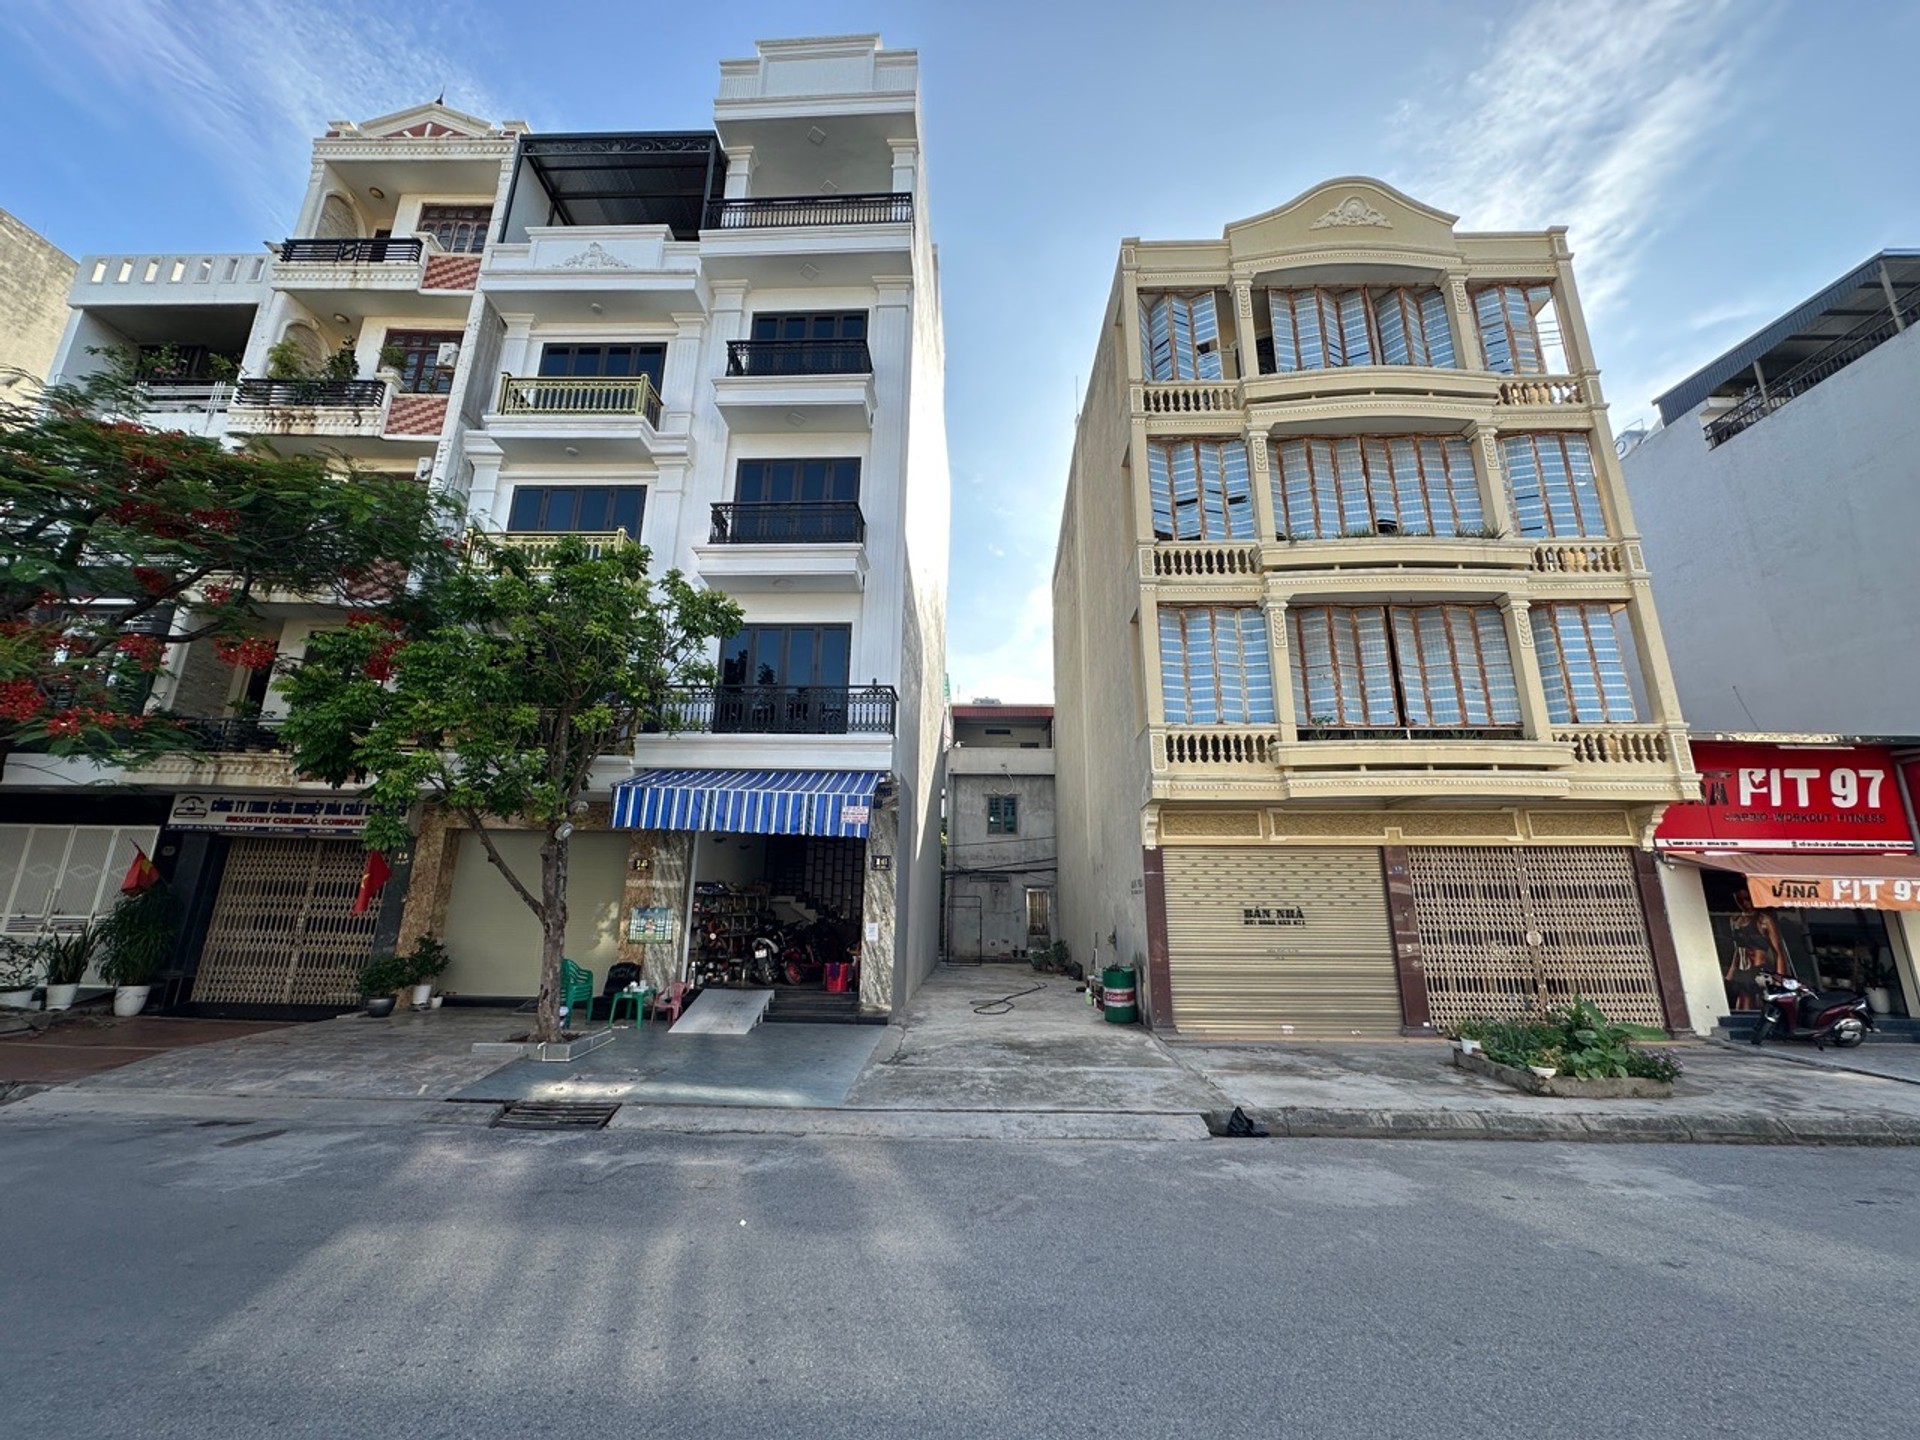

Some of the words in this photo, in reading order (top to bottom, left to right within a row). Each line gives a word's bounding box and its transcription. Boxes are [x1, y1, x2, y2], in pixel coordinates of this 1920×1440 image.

[1738, 768, 1820, 807] FIT
[1830, 768, 1885, 808] 97
[225, 815, 271, 825] INDUSTRY
[272, 816, 319, 826] CHEMICAL
[321, 818, 366, 827] COMPANY
[1837, 813, 1885, 824] FITNESS
[1772, 880, 1820, 899] VINA
[1831, 879, 1885, 901] FIT
[1244, 906, 1271, 918] BÁN
[1276, 906, 1304, 918] NHÀ
